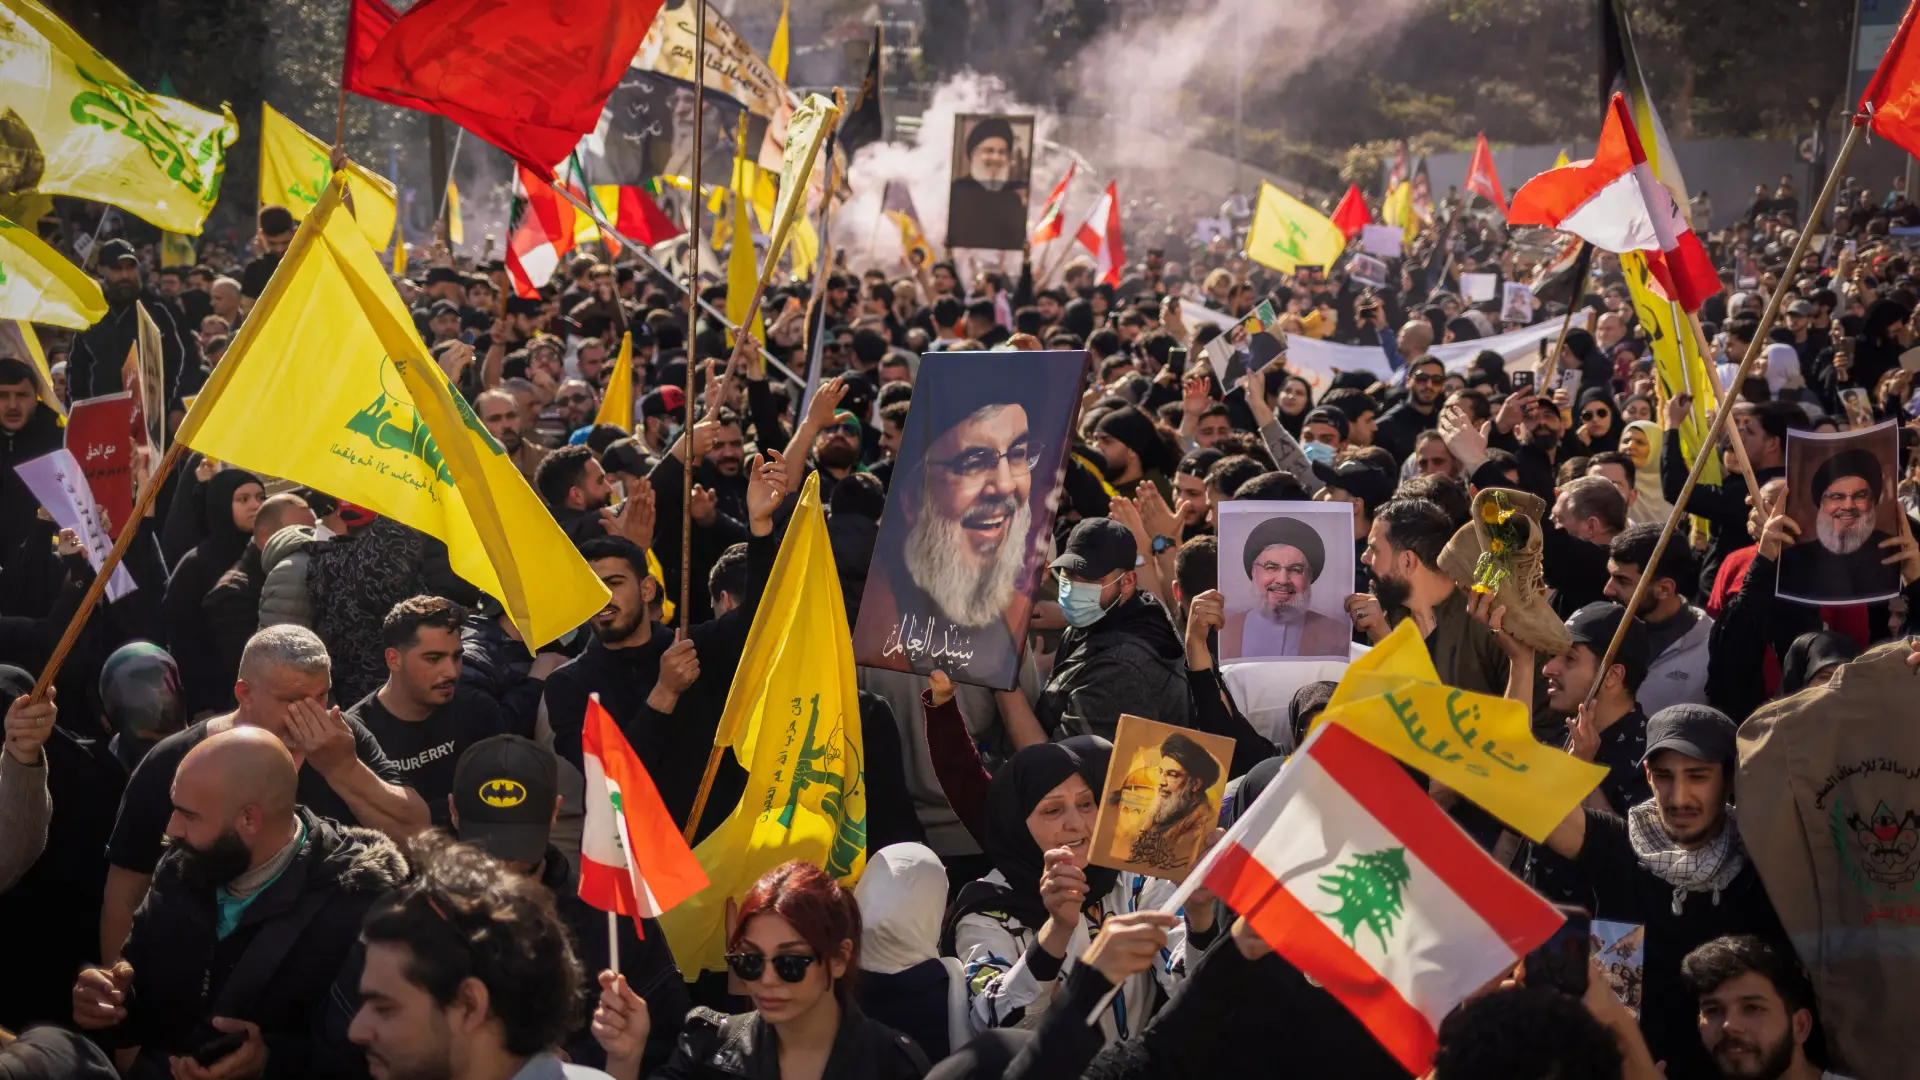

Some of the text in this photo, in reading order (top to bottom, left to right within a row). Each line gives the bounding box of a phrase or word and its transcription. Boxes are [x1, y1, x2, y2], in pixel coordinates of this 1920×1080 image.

[103, 444, 116, 459] مع
[882, 613, 935, 661] العالم
[784, 720, 797, 747] حزب
